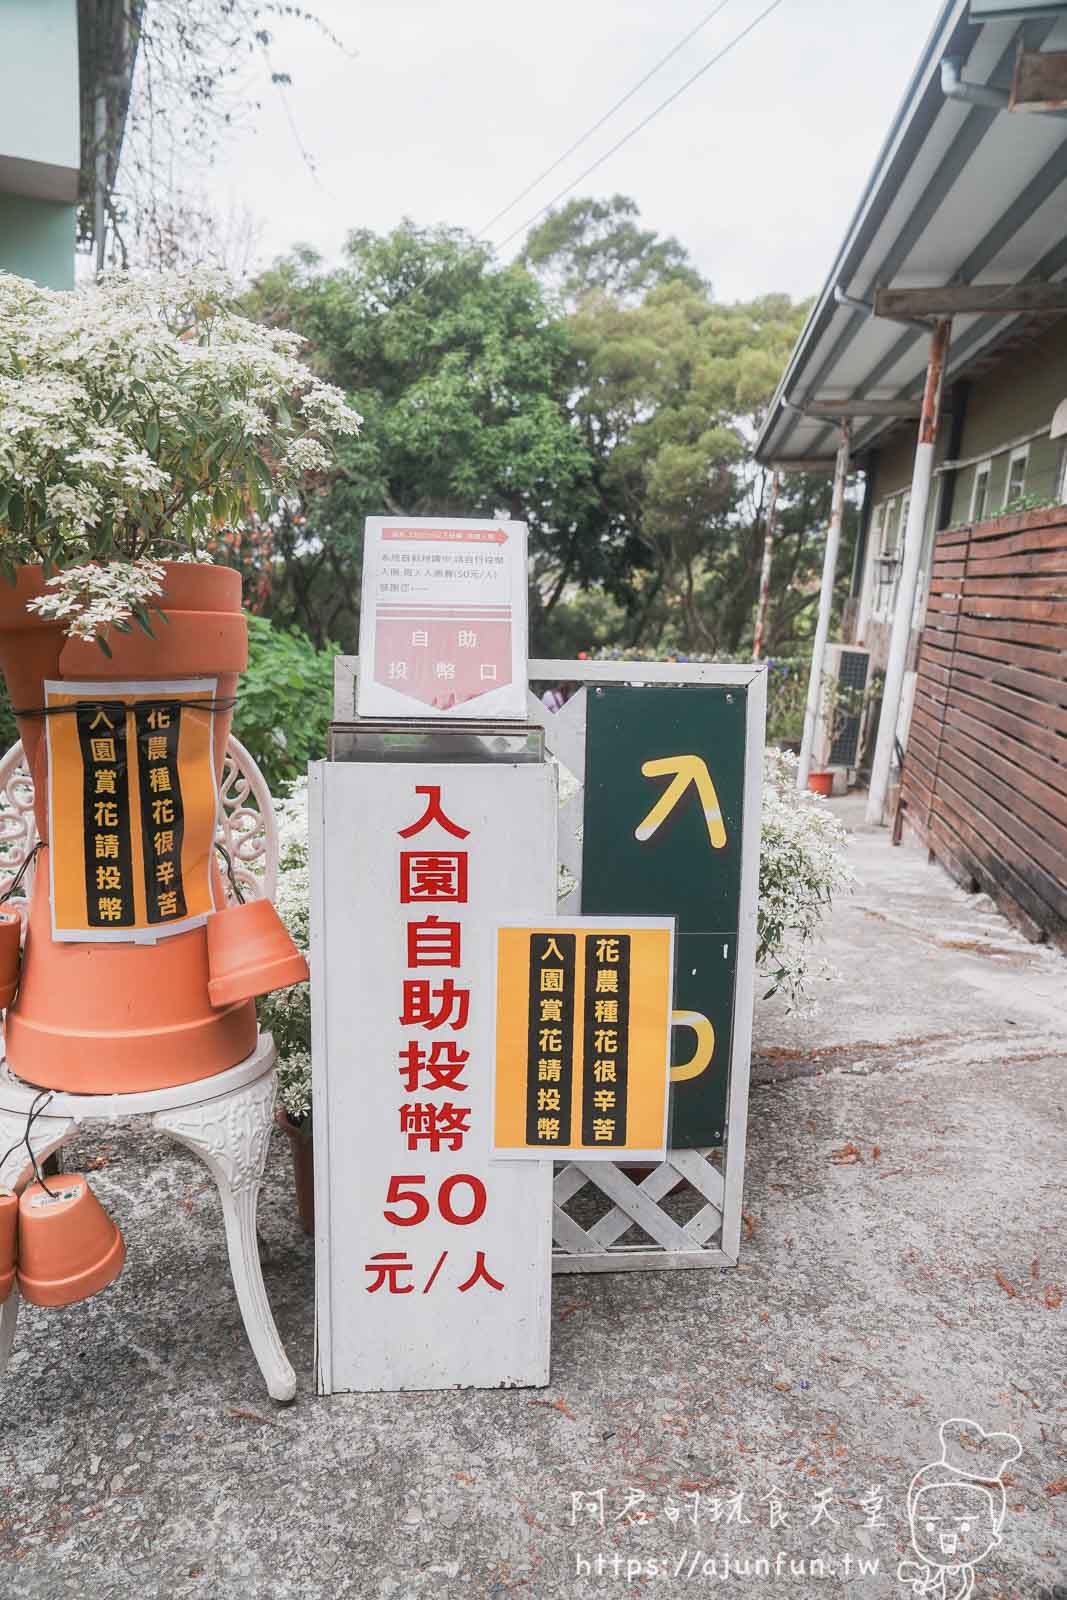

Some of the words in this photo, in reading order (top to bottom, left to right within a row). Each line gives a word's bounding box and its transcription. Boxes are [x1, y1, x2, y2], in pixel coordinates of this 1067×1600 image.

[388, 661, 497, 681] 投幣口
[411, 629, 478, 648] 自助
[88, 708, 123, 921] 入園賞花請投幣
[146, 706, 179, 921] 花農種花很辛苦
[397, 784, 473, 1153] 入園自助投幣
[536, 937, 565, 1141] 入園賞花請投幣
[593, 938, 620, 1141] 花農種花很辛苦
[363, 1250, 506, 1295] 元/人
[383, 1172, 488, 1227] 50
